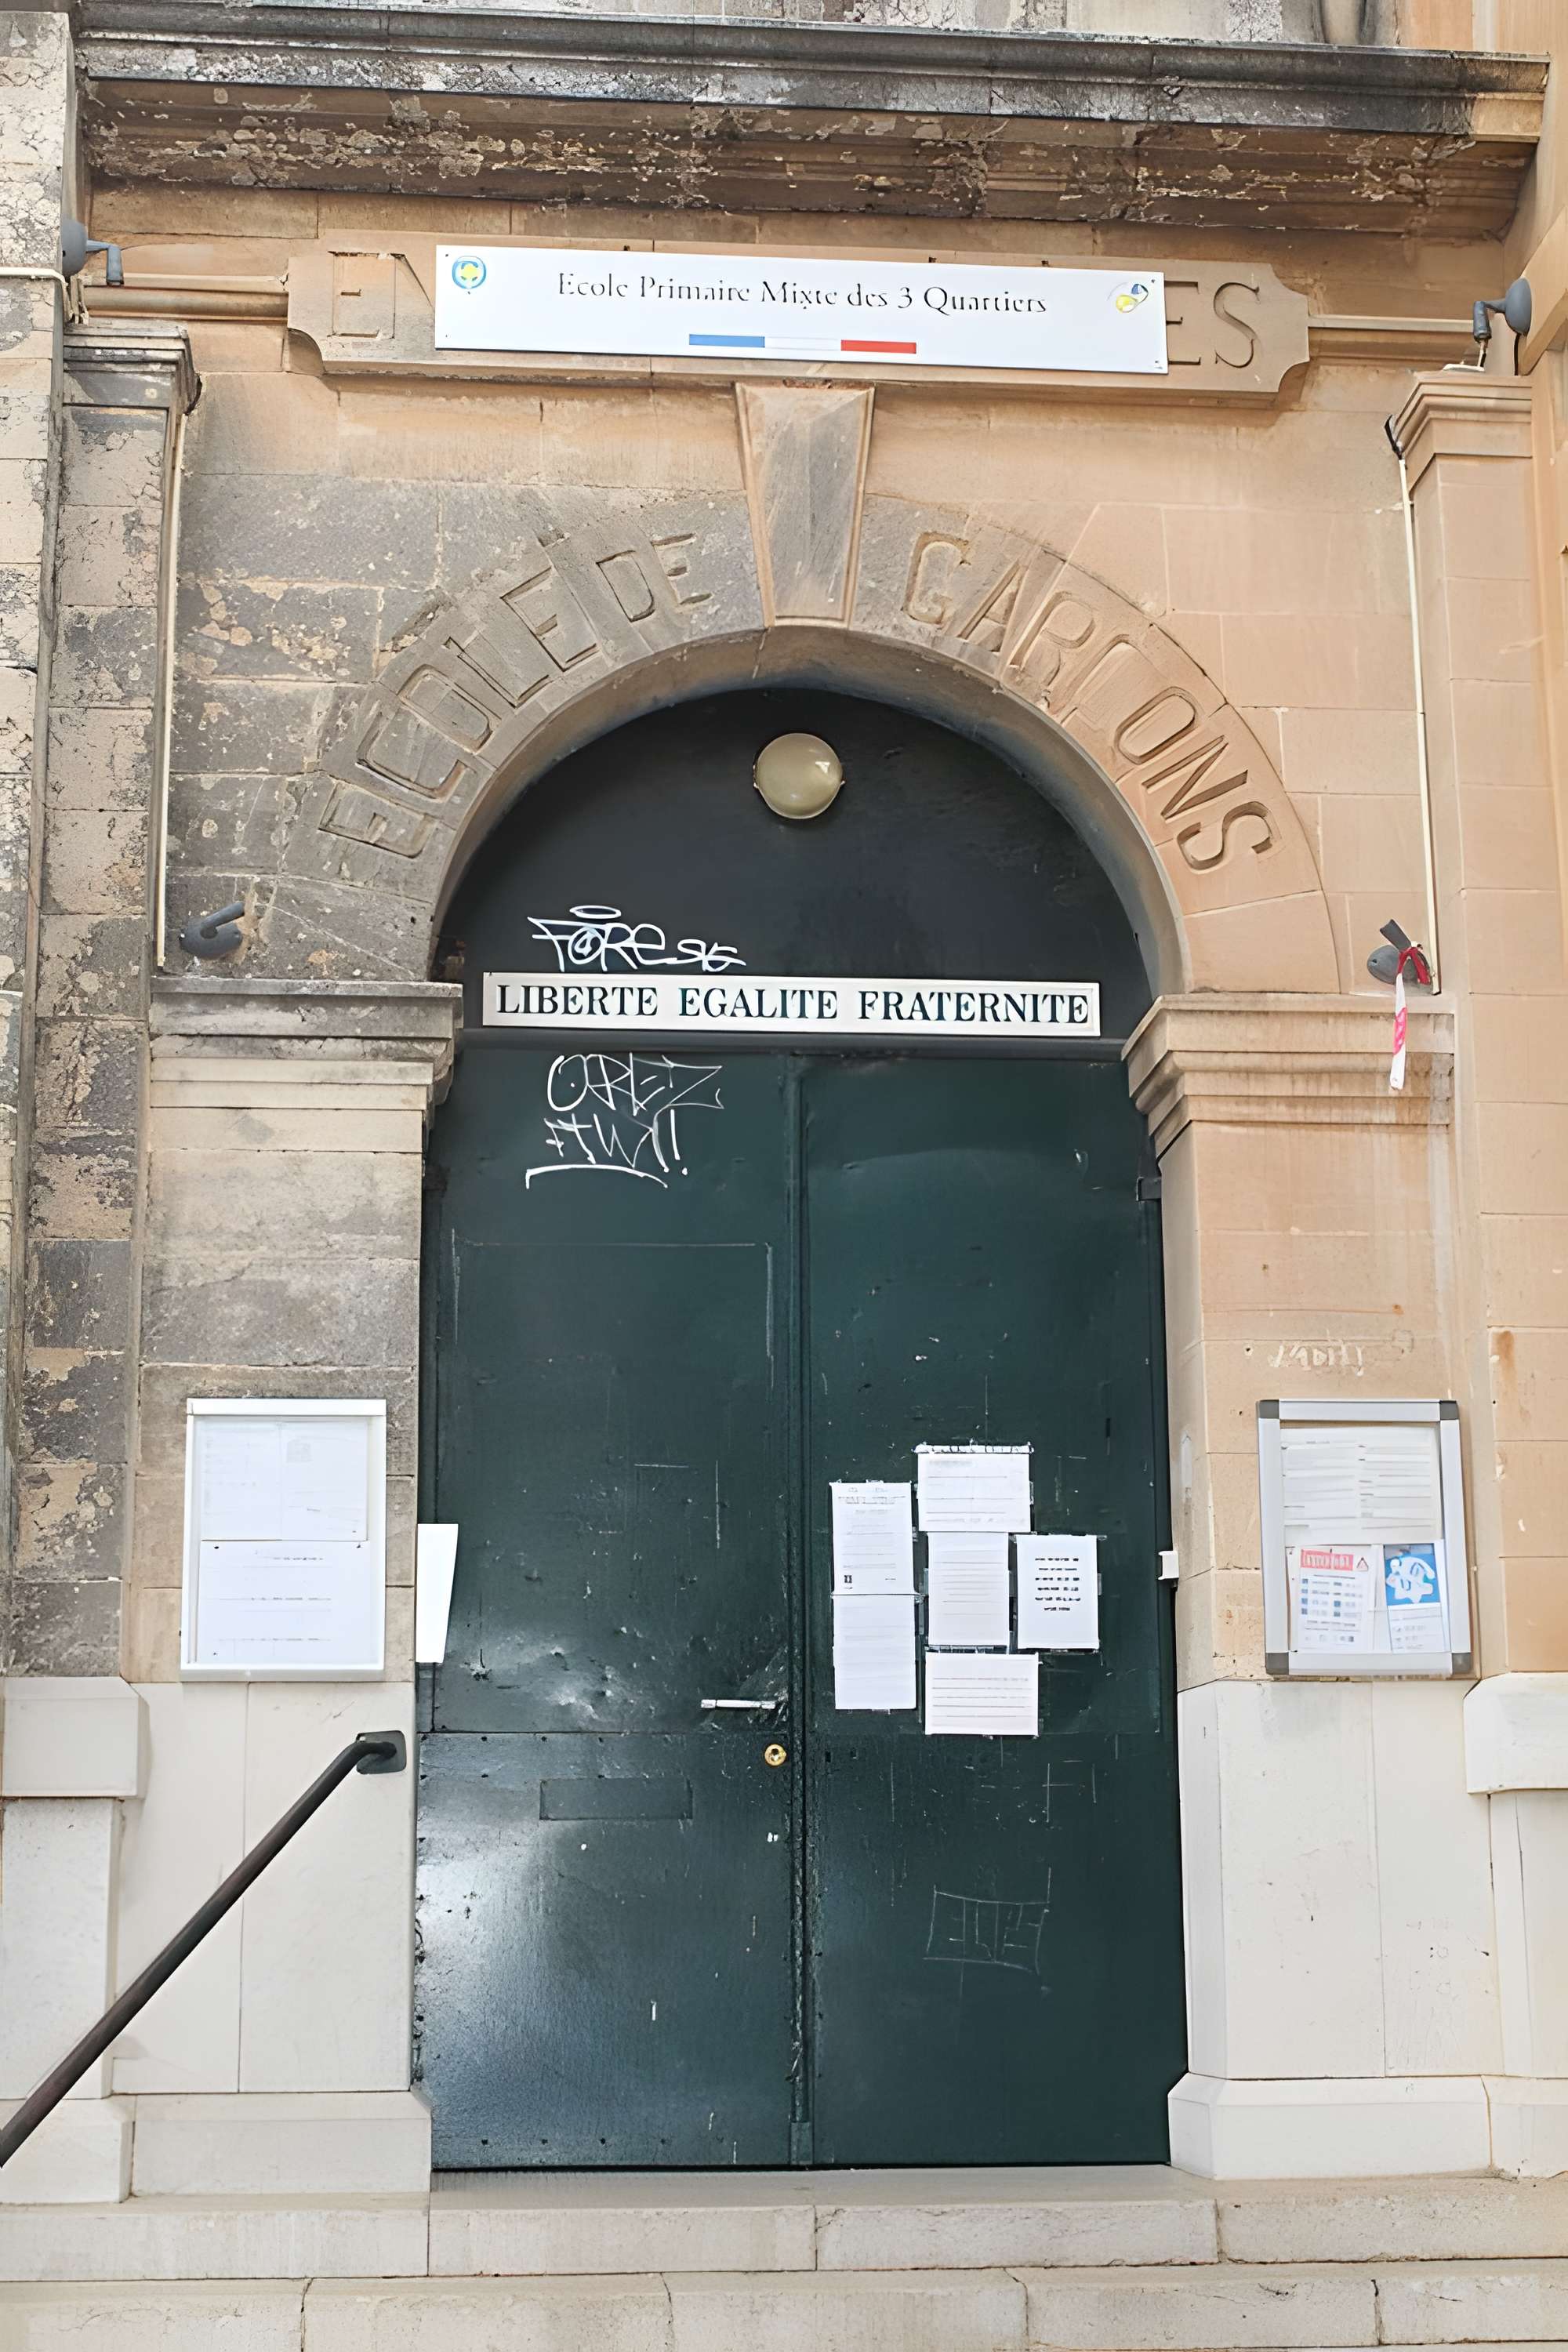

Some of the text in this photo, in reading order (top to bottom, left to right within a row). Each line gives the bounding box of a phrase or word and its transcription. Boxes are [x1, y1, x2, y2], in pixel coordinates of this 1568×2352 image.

[557, 272, 1047, 316] Ecole Primaire Mixte des 3 Quartiers
[316, 565, 602, 859] ECOLE
[594, 532, 715, 623] DE
[495, 984, 1090, 1024] LIBERTE EGALITE FRATERNITE
